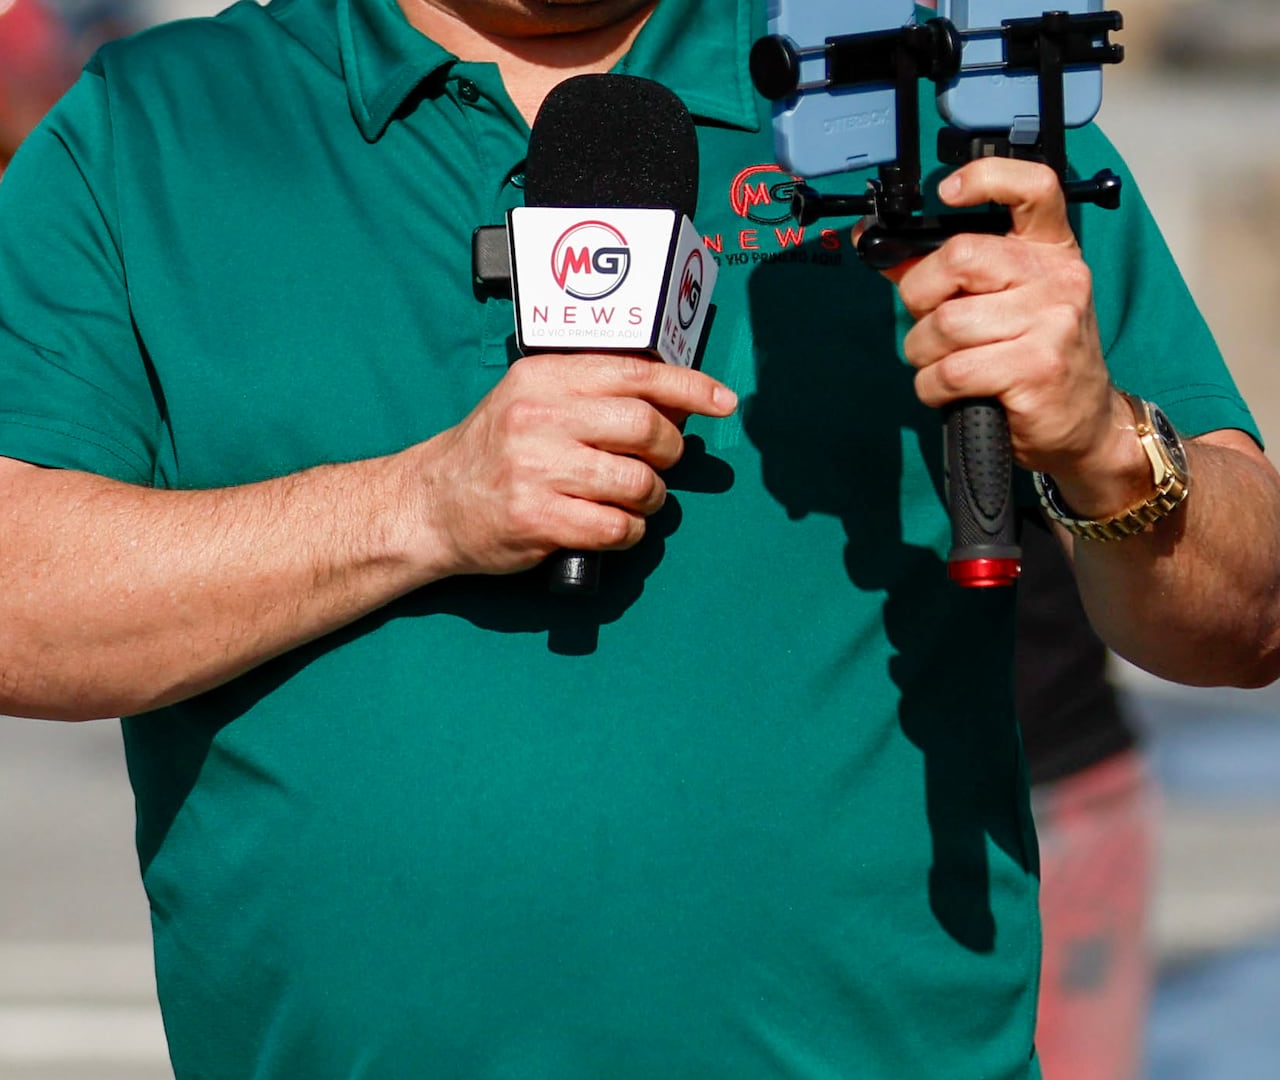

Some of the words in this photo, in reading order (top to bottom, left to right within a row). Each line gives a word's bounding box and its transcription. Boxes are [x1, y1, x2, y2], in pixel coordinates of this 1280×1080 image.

[741, 181, 806, 217] MG
[703, 226, 841, 253] NEWS
[555, 246, 632, 290] MG
[680, 268, 702, 312] MG
[531, 328, 545, 337] LO
[548, 328, 566, 337] VIO
[568, 328, 615, 338] PRIMERO
[617, 328, 643, 339] AQUI
[533, 306, 643, 325] NEWS
[665, 314, 692, 366] NEWS
